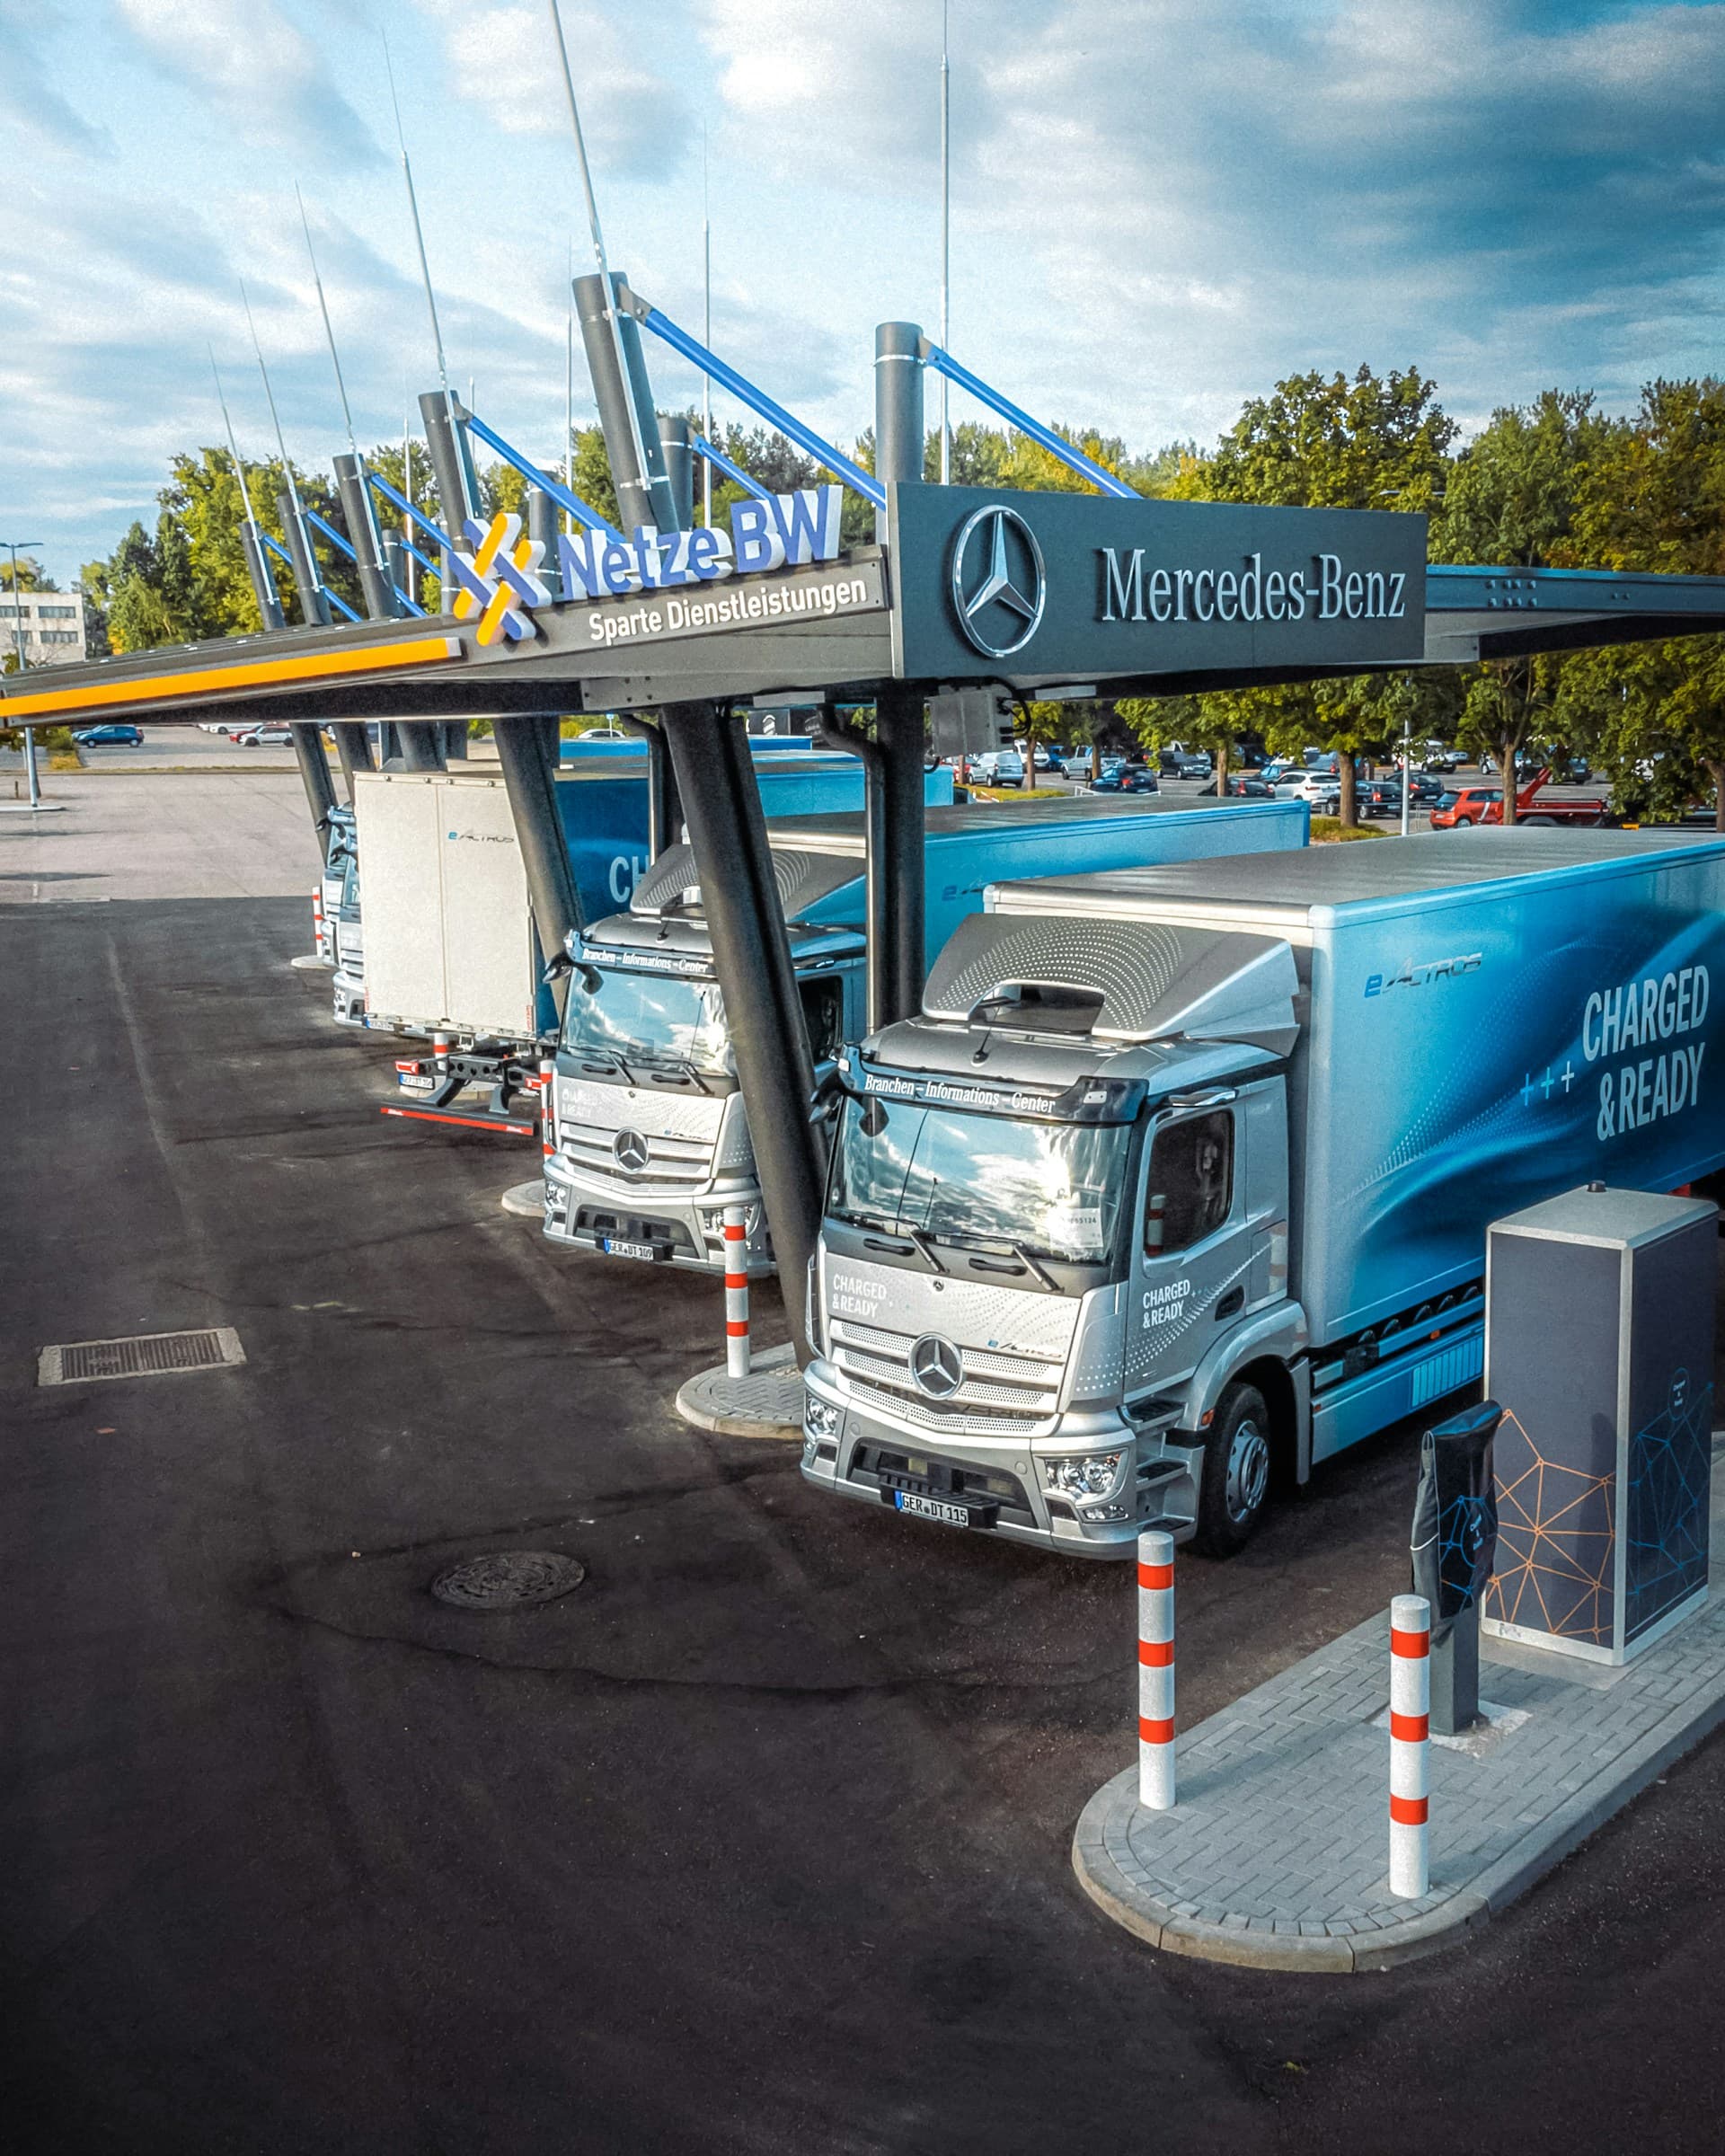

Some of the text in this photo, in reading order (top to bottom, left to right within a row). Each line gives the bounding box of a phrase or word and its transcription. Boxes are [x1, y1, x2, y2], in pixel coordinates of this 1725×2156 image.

[1101, 547, 1406, 622] Mercedes-Benz
[588, 579, 867, 645] Sparte Dienstleistungen
[1583, 965, 1710, 1062] CHARGED
[924, 1081, 1000, 1106] Informations
[1011, 1091, 1056, 1113] Center
[833, 1273, 887, 1300] CHARGED
[1142, 1279, 1190, 1309] CHARGED
[902, 1495, 967, 1524] GER DT 115
